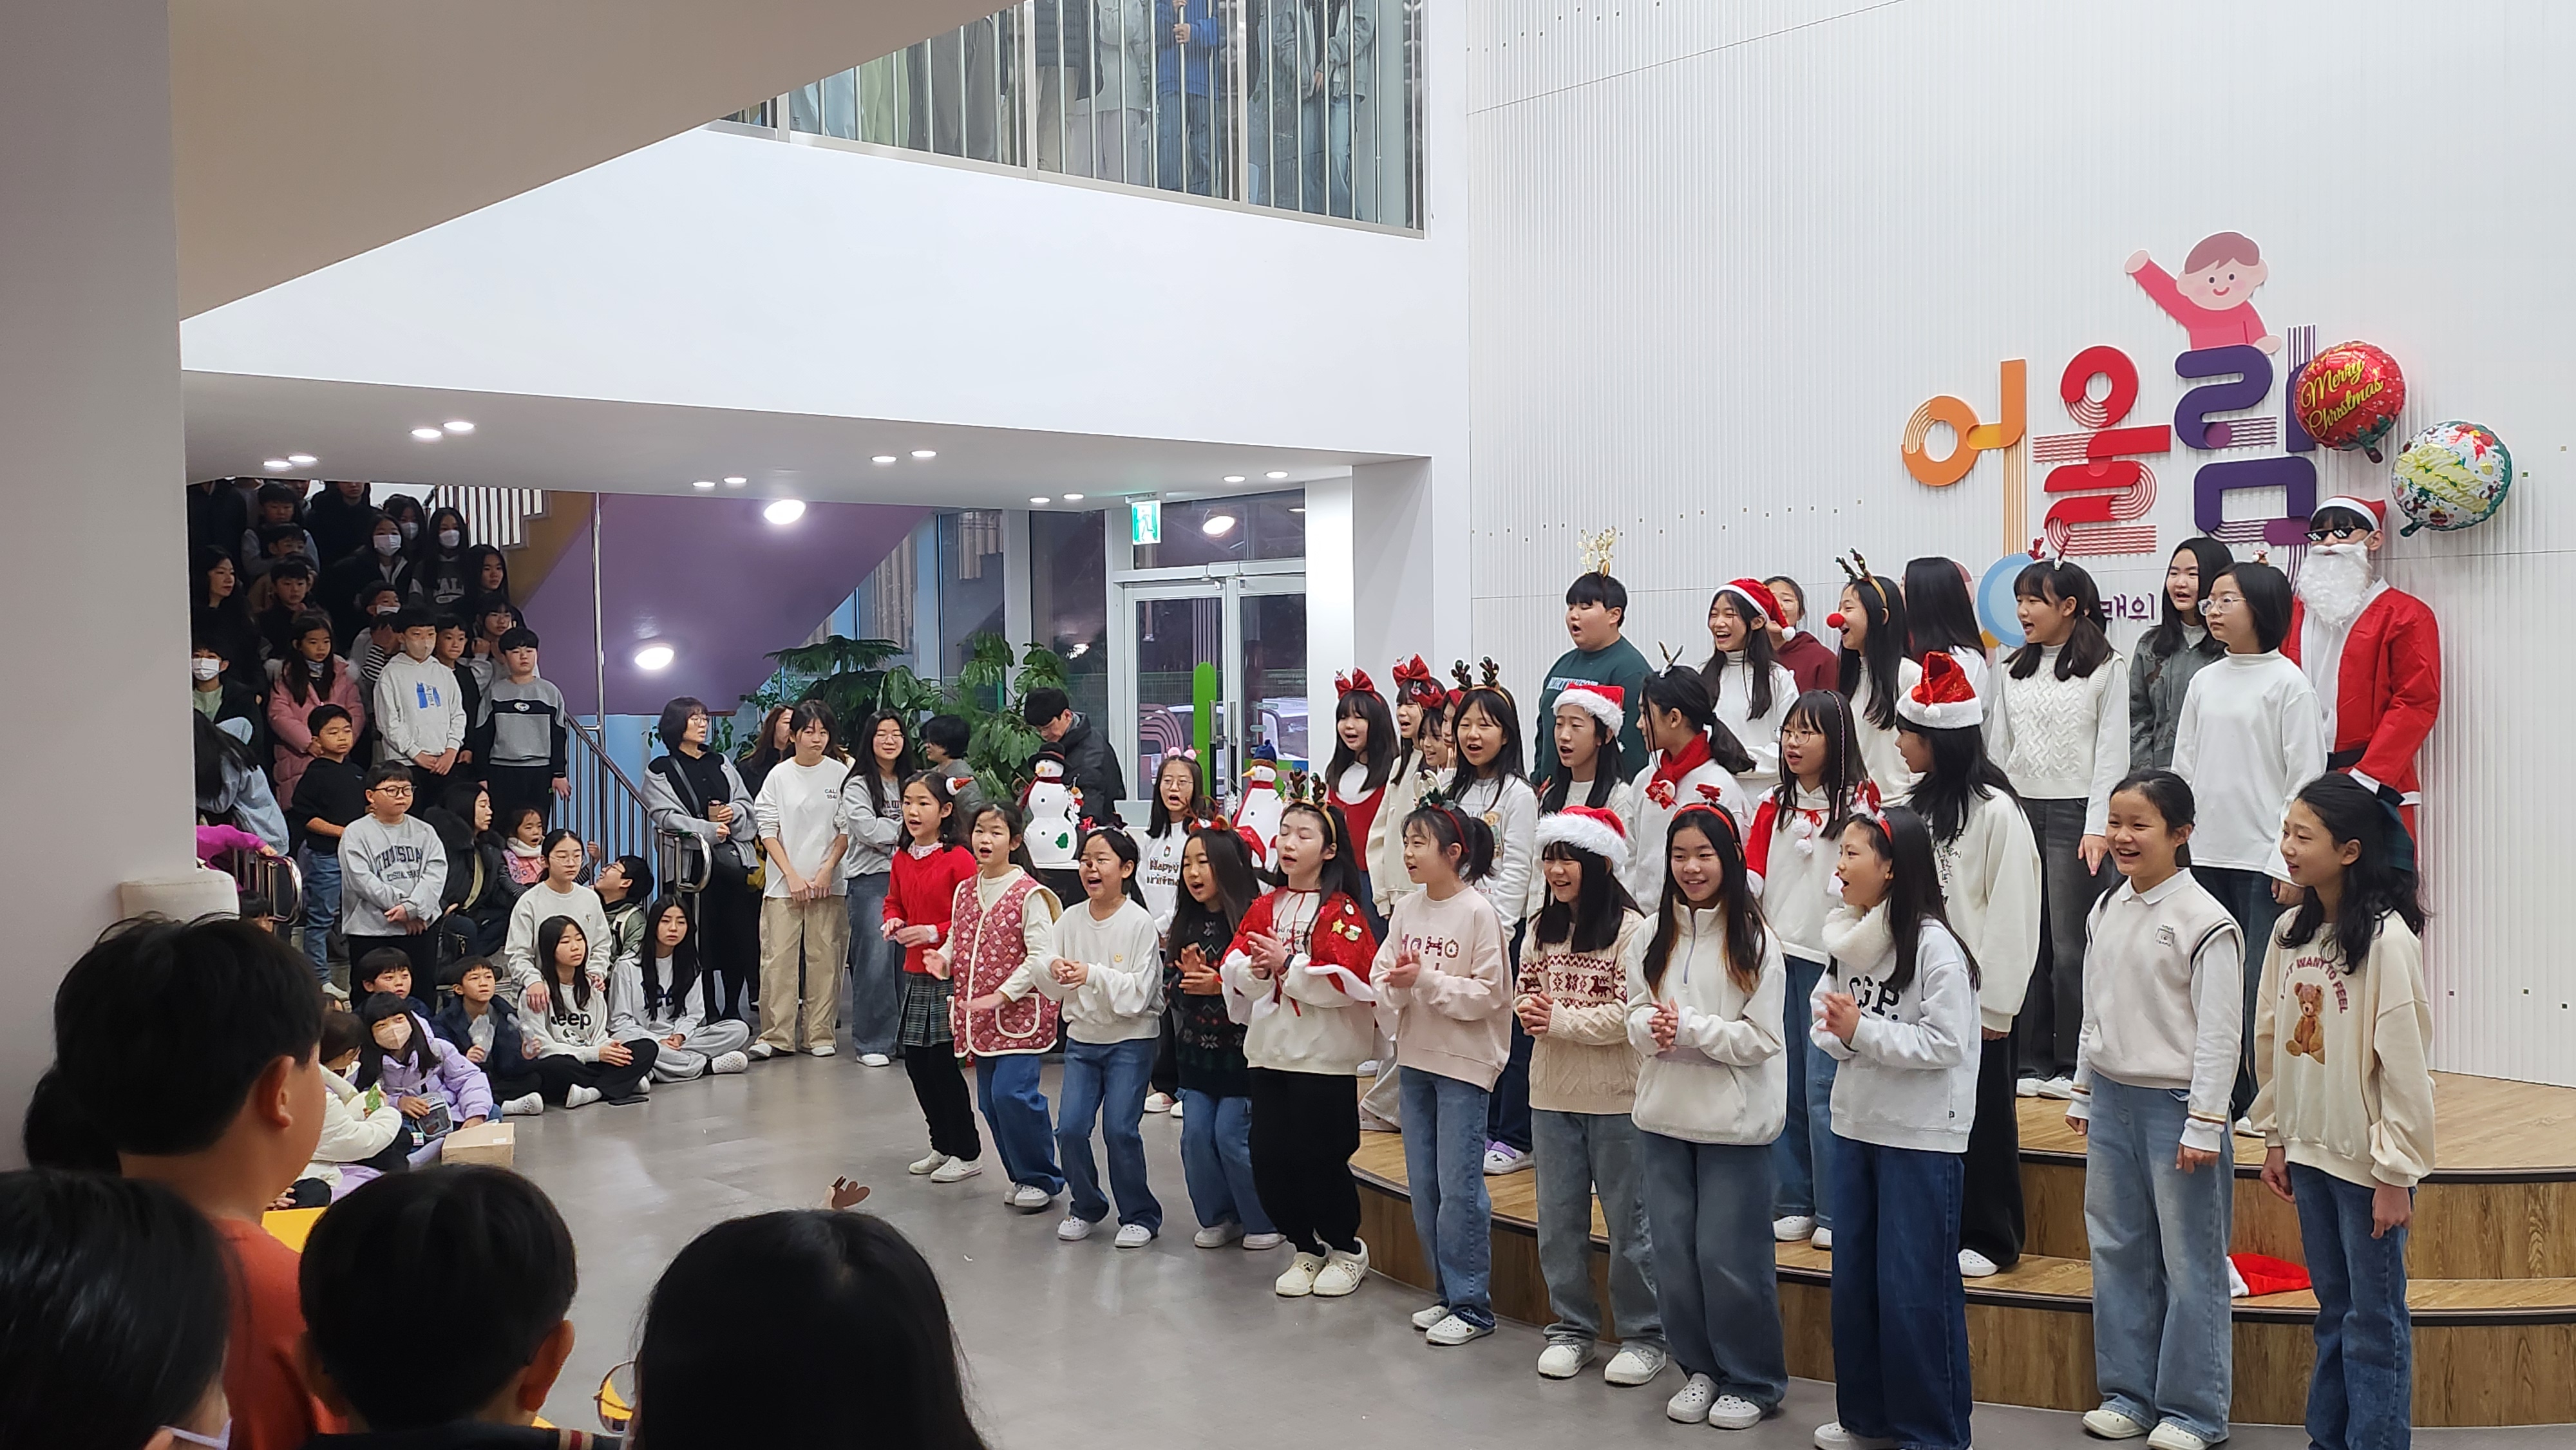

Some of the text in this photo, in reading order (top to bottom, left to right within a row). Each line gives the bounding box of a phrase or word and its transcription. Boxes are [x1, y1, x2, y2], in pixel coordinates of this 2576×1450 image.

[2301, 359, 2365, 408] Merry
[2305, 369, 2384, 438] Christmas
[2297, 956, 2324, 970] WANT
[2333, 980, 2349, 1015] FEEL
